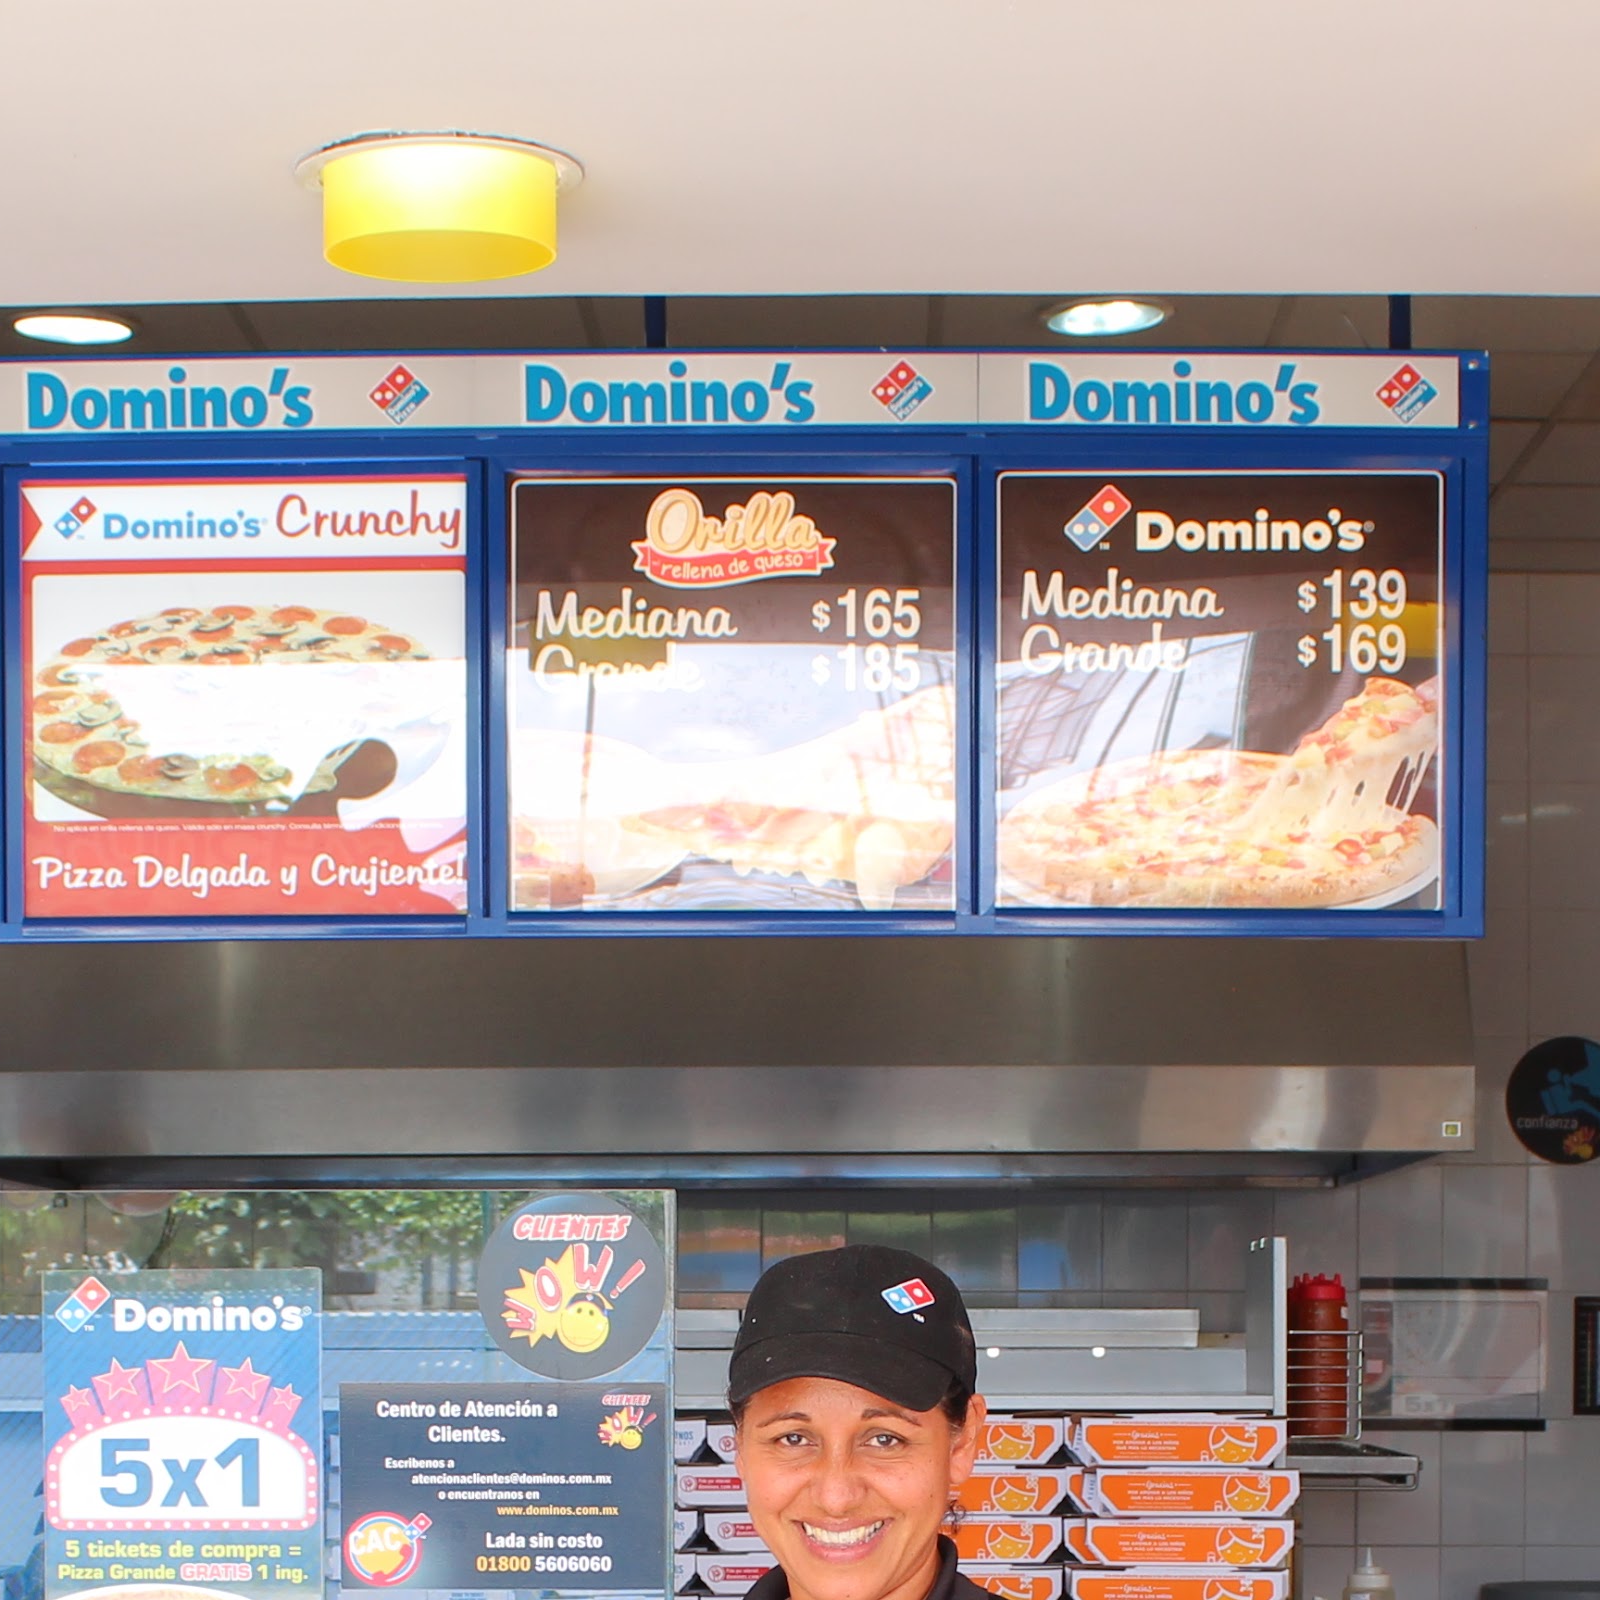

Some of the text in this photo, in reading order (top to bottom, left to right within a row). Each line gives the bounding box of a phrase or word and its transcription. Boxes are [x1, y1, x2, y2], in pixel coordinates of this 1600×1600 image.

[27, 367, 314, 429] Domino's
[525, 361, 815, 422] Domino's
[1029, 360, 1320, 423] Domino's
[103, 489, 461, 548] Domino's Crunchy
[647, 490, 820, 553] Orilla
[1137, 507, 1366, 552] Domino's
[661, 552, 804, 580] rellena de queso
[1021, 567, 1408, 621] Mediana $139
[535, 587, 922, 640] Mediana $165
[1020, 622, 1408, 674] Grande $169
[811, 642, 922, 692] $185
[32, 854, 126, 889] Pizza
[133, 853, 270, 897] Delgada
[280, 864, 298, 896] y
[1516, 1114, 1579, 1129] confianza
[513, 1213, 632, 1241] CLIENTES
[114, 1296, 304, 1333] Domino's
[377, 1399, 558, 1418] Centro de Atención a
[428, 1425, 506, 1443] Clientes.
[100, 1438, 261, 1508] 5x1
[411, 1472, 612, 1485] atencionaclientes@dominos.com.mx
[447, 1459, 455, 1469] a
[438, 1489, 540, 1501] o encuentranos en
[497, 1504, 619, 1516] www.dominos.com.mx
[65, 1539, 302, 1562] 5 tickets de compra =
[349, 1526, 401, 1556] CAC
[486, 1532, 603, 1550] Lada sin costo
[58, 1563, 308, 1583] Pizza Grande GRATIS 1 ing.
[476, 1555, 612, 1572] 01800 5606060
